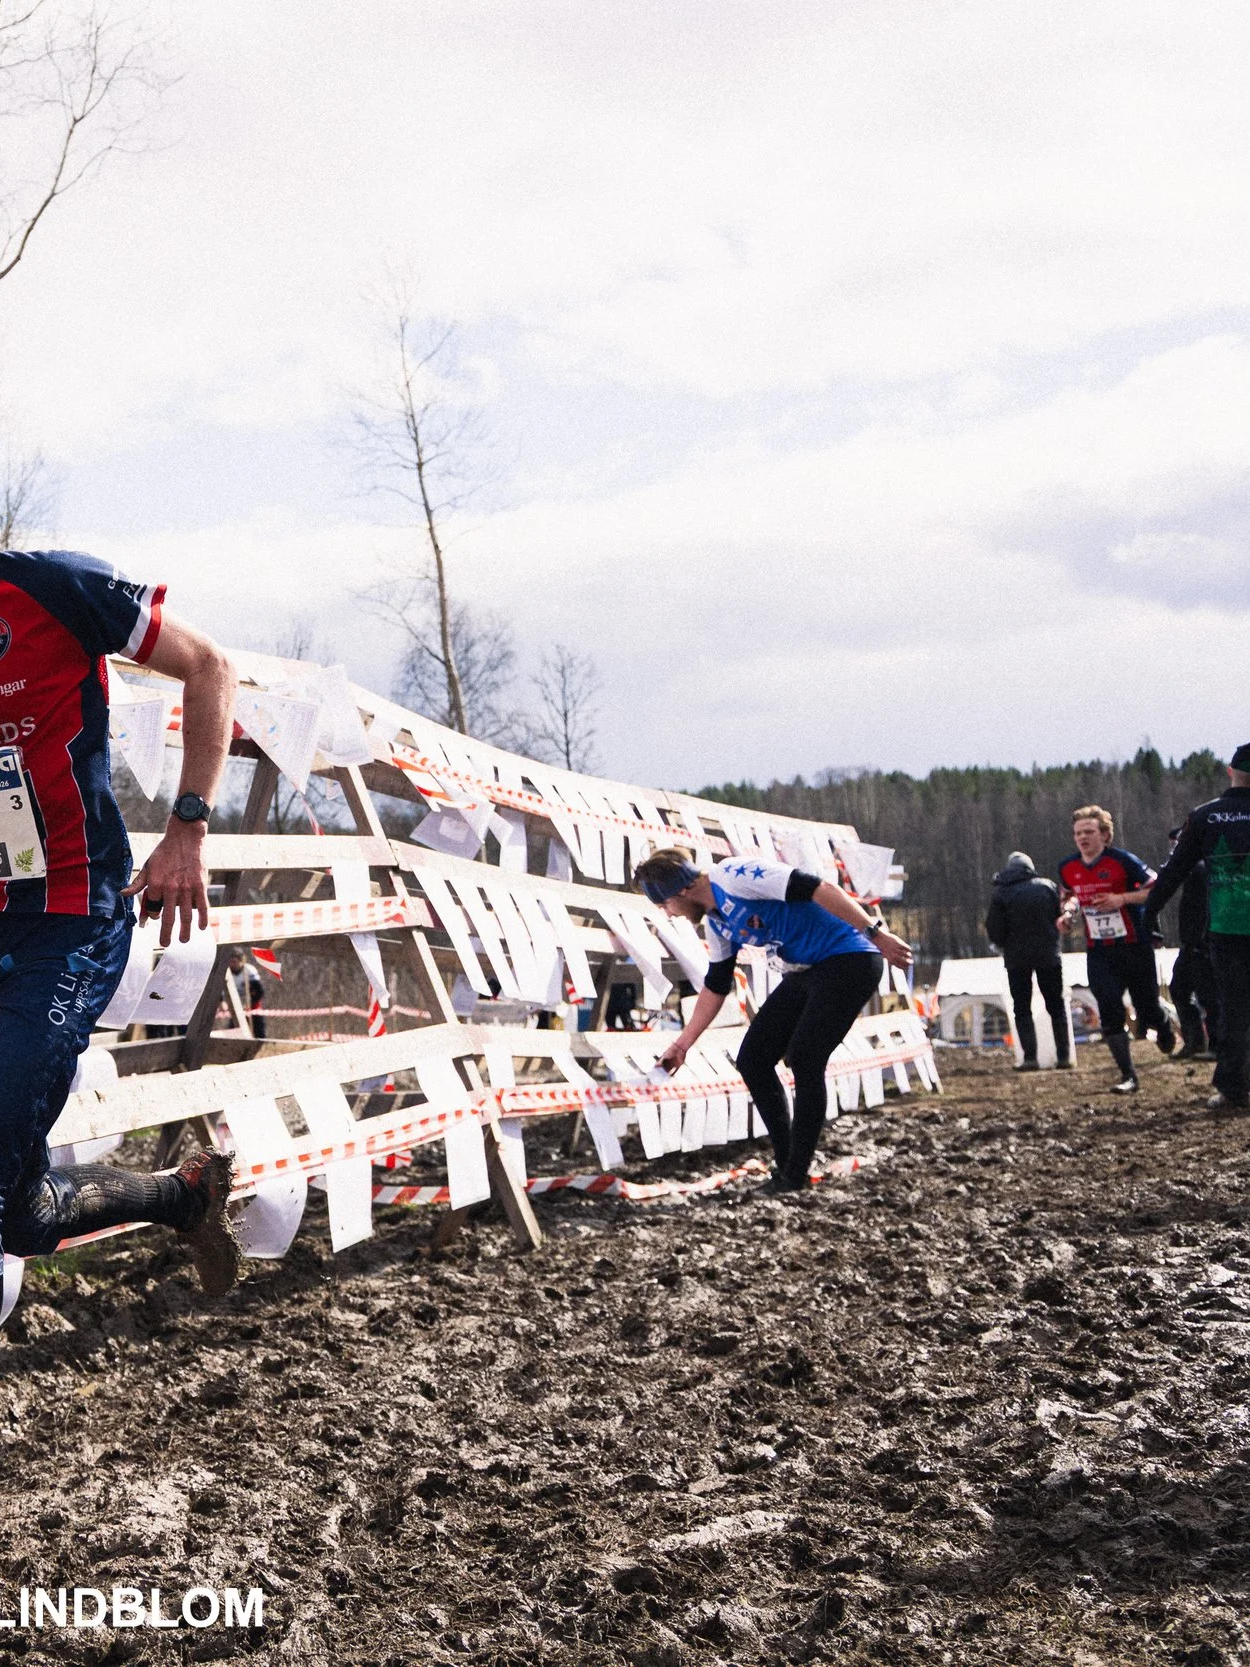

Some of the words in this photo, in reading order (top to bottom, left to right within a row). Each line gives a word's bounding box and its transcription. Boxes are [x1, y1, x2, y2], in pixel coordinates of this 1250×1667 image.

[10, 795, 23, 810] 3
[1095, 917, 1110, 926] 77
[73, 969, 96, 1013] UPPSALA
[48, 995, 71, 1026] OK
